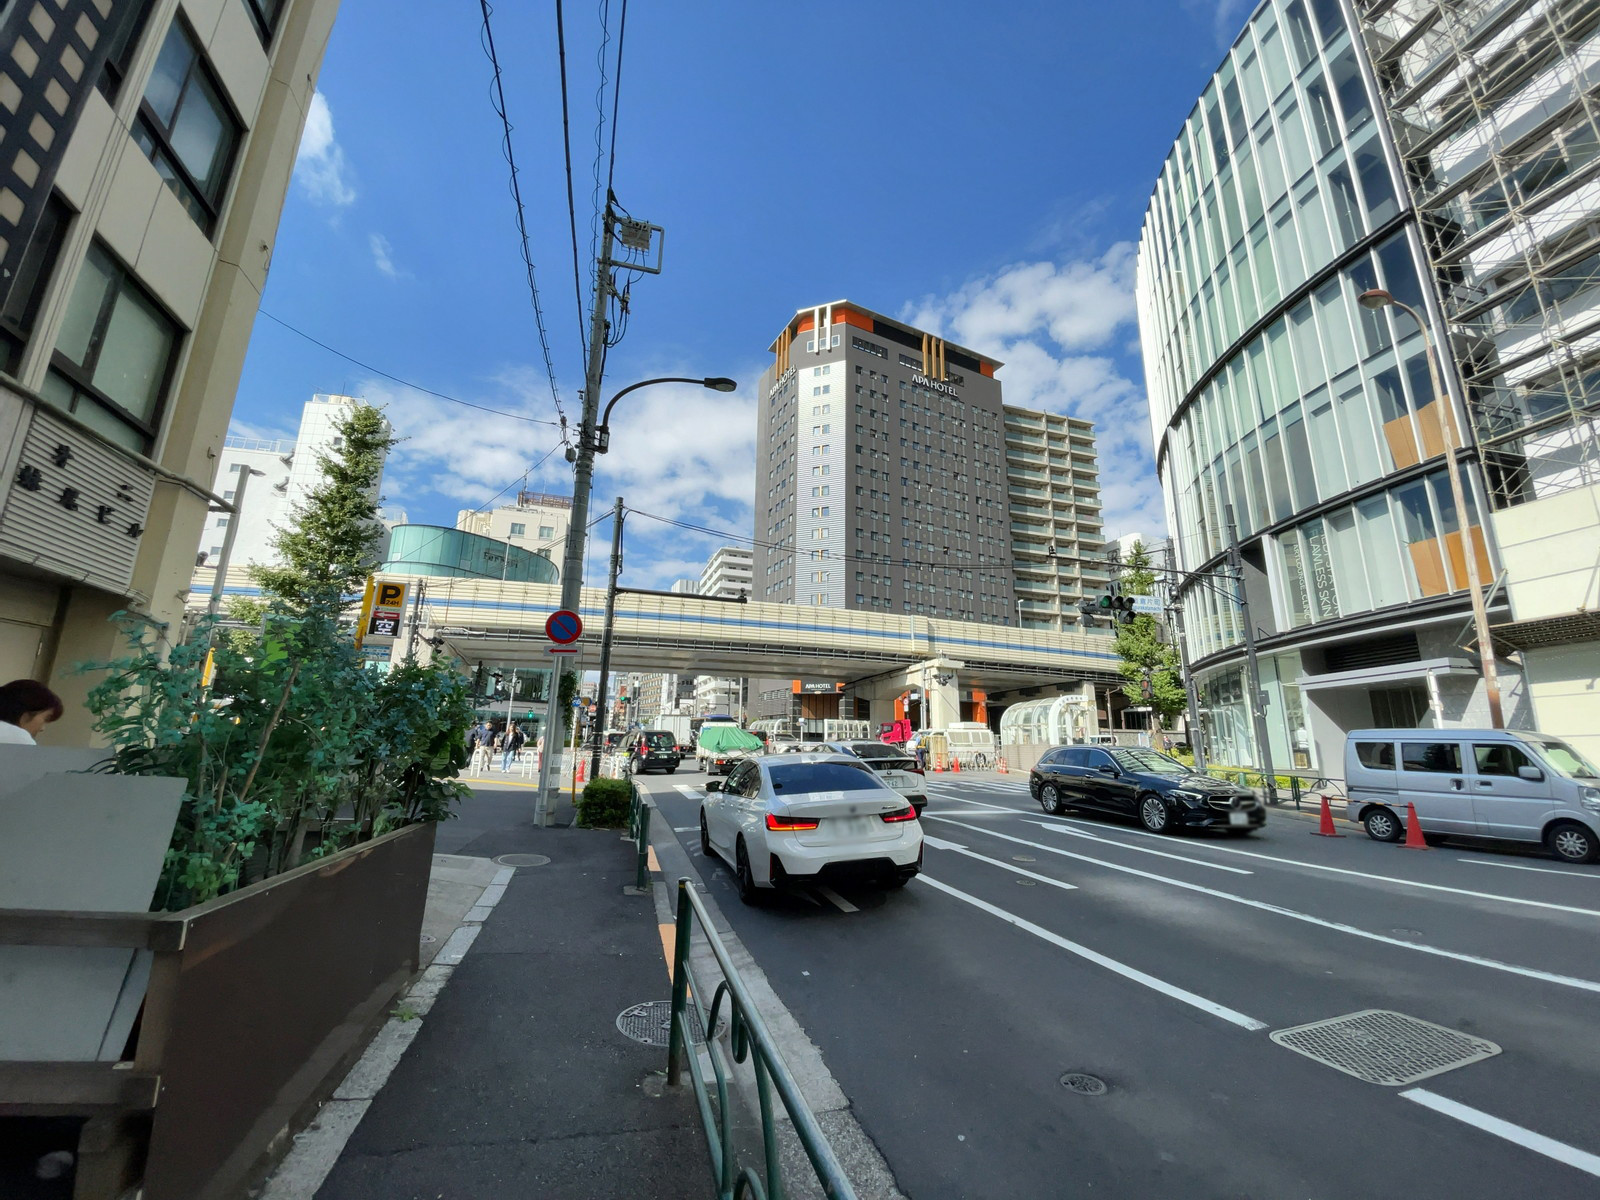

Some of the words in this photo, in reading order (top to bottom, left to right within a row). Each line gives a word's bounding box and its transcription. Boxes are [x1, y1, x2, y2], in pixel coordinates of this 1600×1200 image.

[769, 383, 780, 398] APA
[780, 364, 797, 388] HOTEL
[912, 374, 930, 387] APA
[930, 380, 959, 397] HOTEL
[1309, 528, 1328, 589] FLAWLESS
[1319, 590, 1333, 617] SKIN
[380, 585, 402, 605] P
[374, 619, 395, 635] 空
